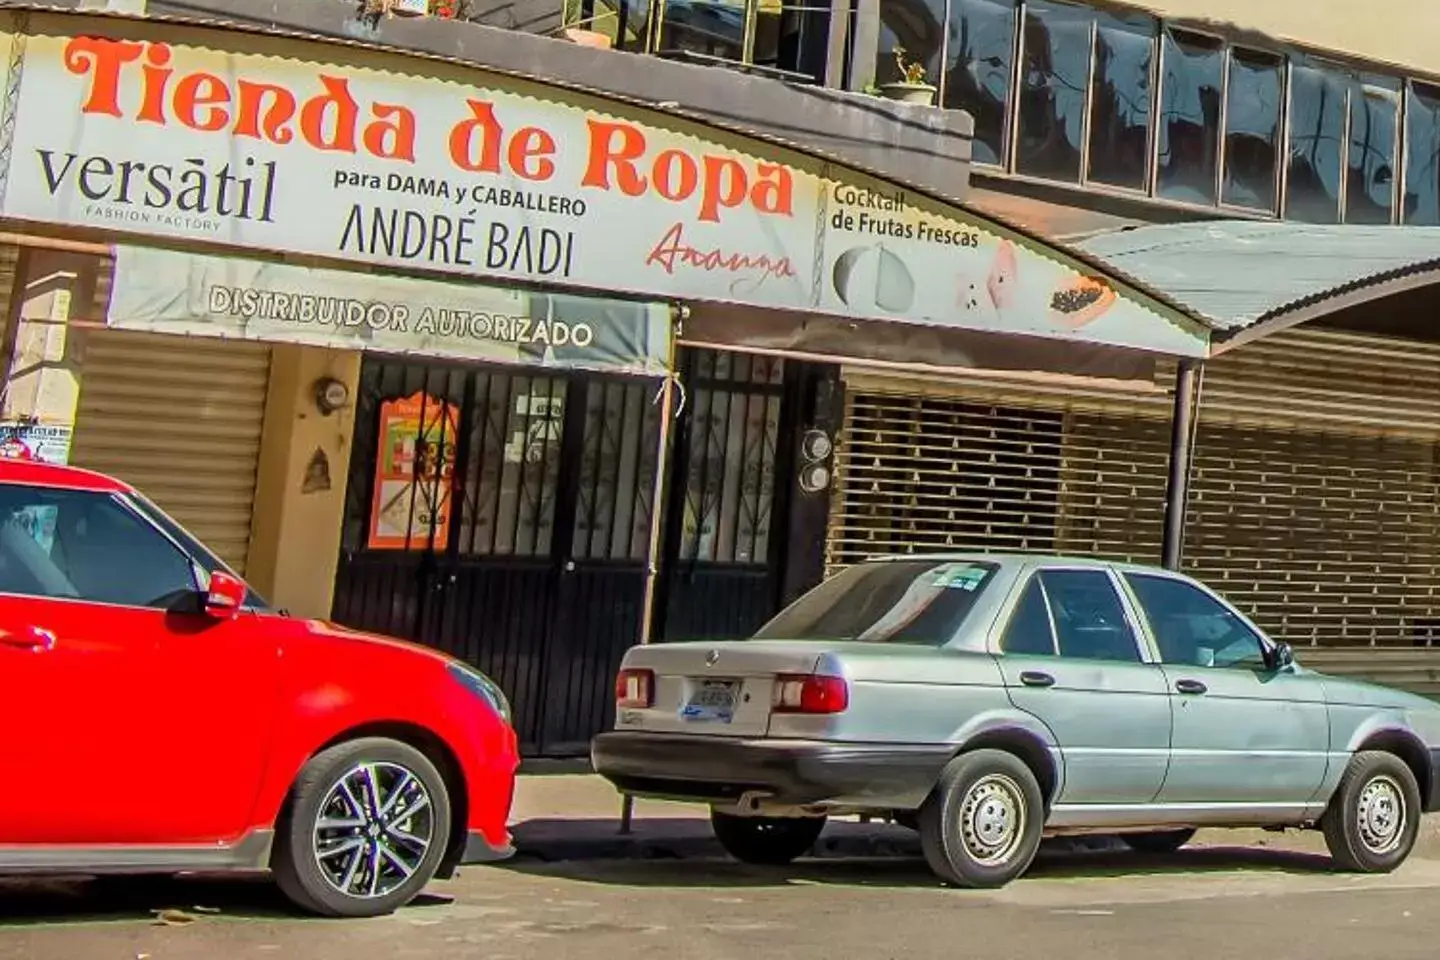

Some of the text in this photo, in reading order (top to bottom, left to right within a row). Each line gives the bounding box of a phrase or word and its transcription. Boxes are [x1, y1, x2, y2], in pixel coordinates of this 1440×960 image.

[64, 32, 795, 224] Tienda de Ropa
[334, 168, 587, 217] para DAMA y CABALLERO
[834, 184, 905, 214] Cocktail
[83, 204, 222, 233] FASHION FACTORY
[338, 203, 574, 278] ANDRÉ BADI
[832, 209, 980, 249] de Frutas Frescas
[209, 284, 593, 348] DISTRIBUIDOR AUTORIZADO
